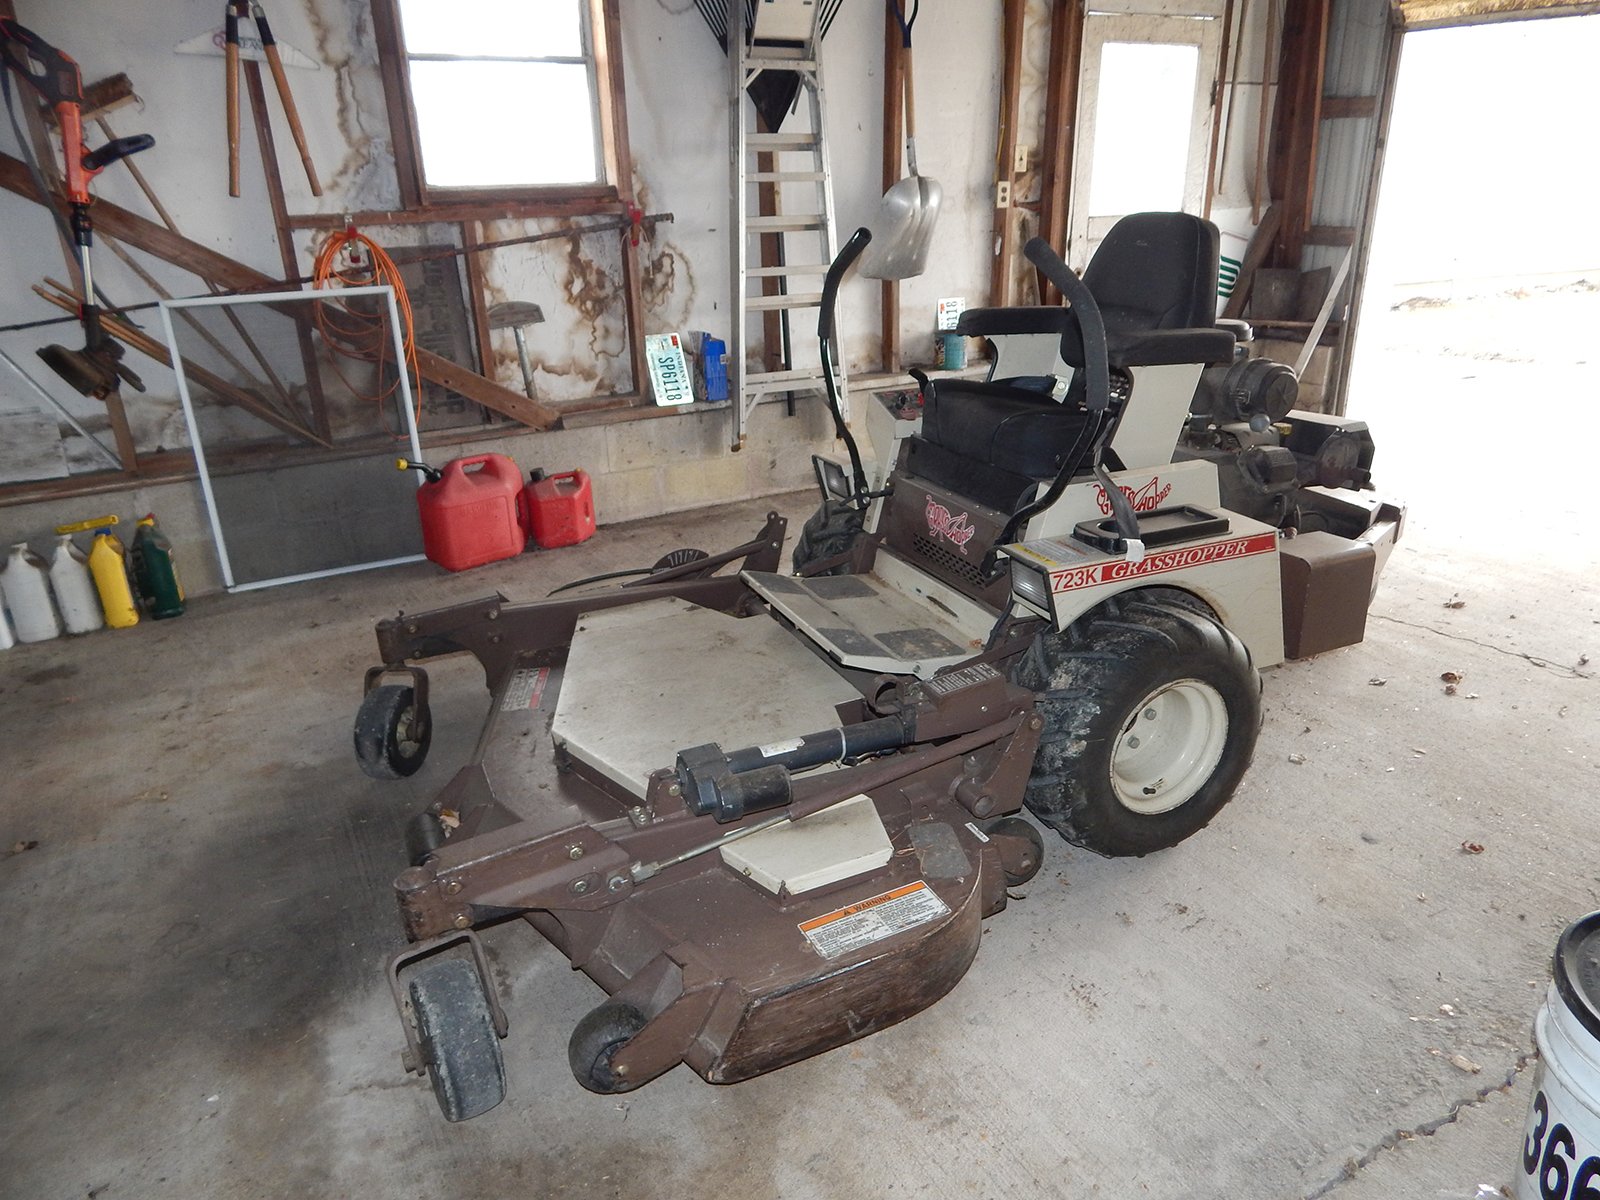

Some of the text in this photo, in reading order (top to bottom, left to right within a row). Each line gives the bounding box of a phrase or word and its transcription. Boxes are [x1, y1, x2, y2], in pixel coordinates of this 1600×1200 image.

[658, 356, 683, 401] SP6118
[675, 351, 687, 383] INDIANA
[1053, 566, 1098, 592] 723K
[1111, 540, 1249, 579] GRASSHOPPER
[855, 894, 892, 913] WARNING
